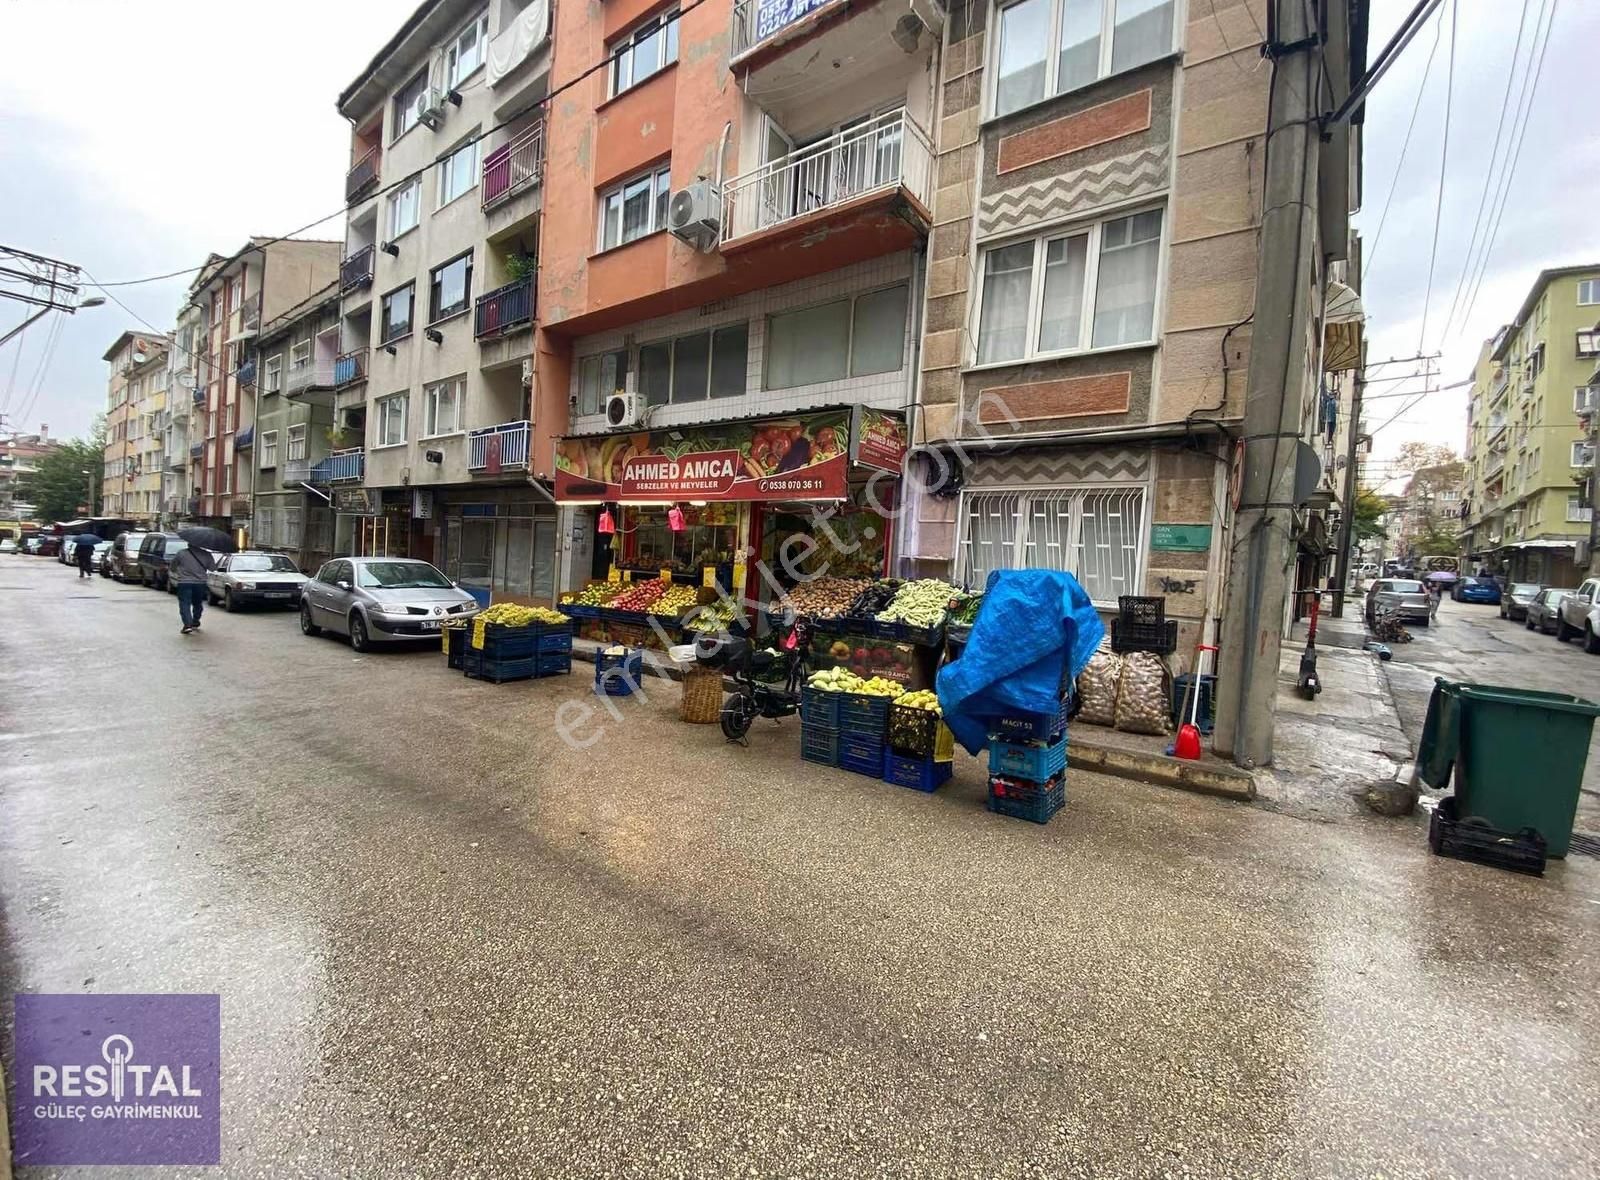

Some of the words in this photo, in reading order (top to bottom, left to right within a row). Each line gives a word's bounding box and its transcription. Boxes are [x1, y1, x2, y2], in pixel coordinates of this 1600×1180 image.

[624, 463, 680, 481] AHMED
[682, 459, 734, 479] AMCA
[636, 482, 669, 490] SEBZELER
[680, 481, 719, 489] MEYVELER
[769, 481, 786, 490] 0538
[787, 481, 800, 489] 070
[802, 481, 812, 489] 36
[814, 480, 822, 489] 11
